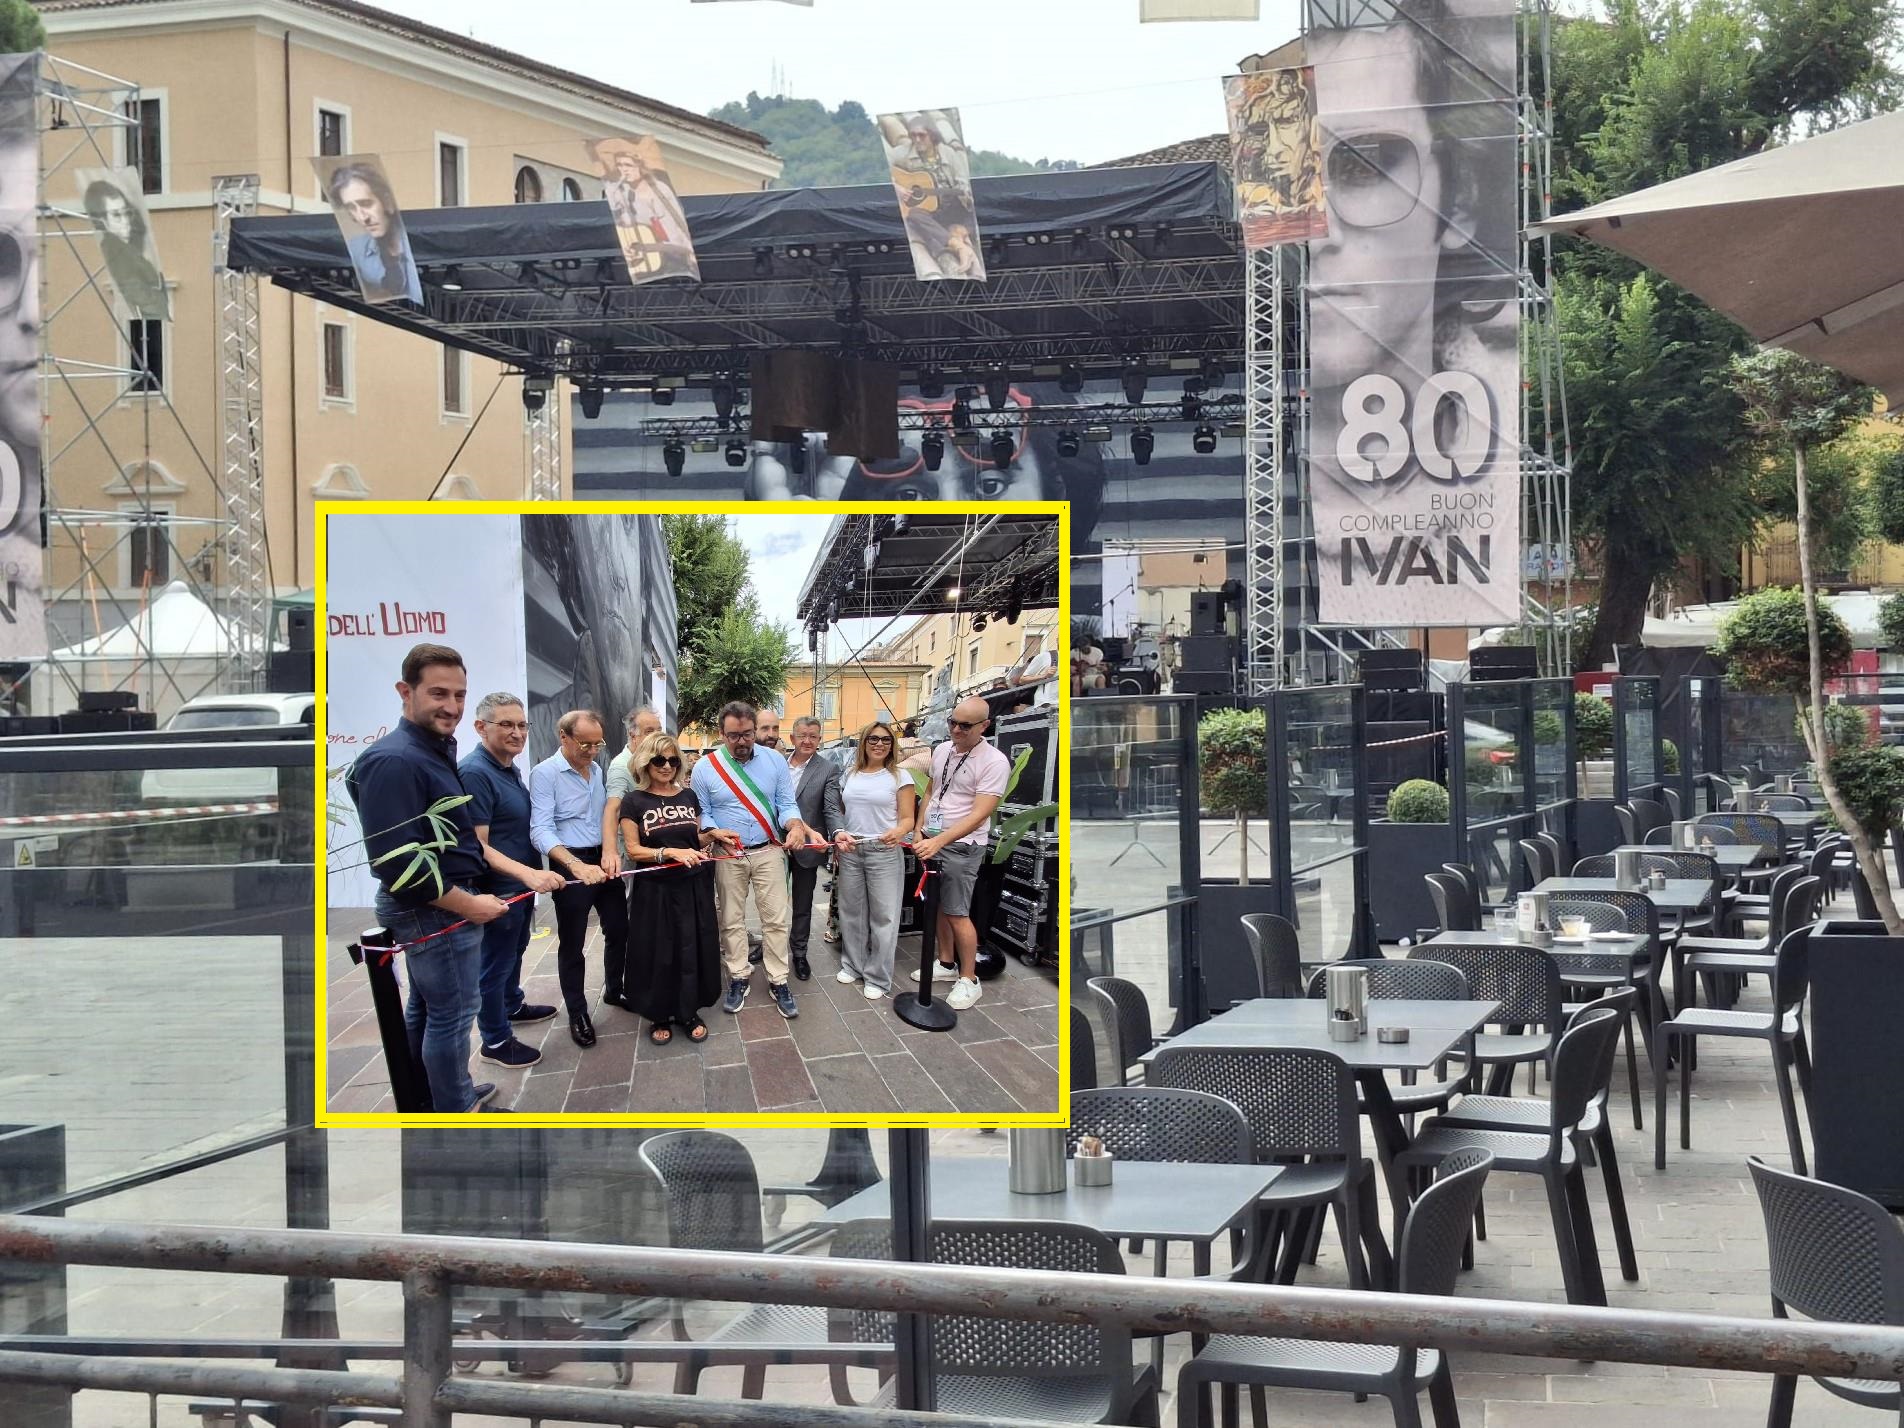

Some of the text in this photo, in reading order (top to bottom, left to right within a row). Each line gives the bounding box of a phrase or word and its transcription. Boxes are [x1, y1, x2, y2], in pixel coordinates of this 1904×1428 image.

[1336, 371, 1491, 482] 80
[1431, 492, 1494, 510] BUON
[1339, 512, 1494, 532] COMPLEANNO
[1341, 534, 1491, 586] IVAN
